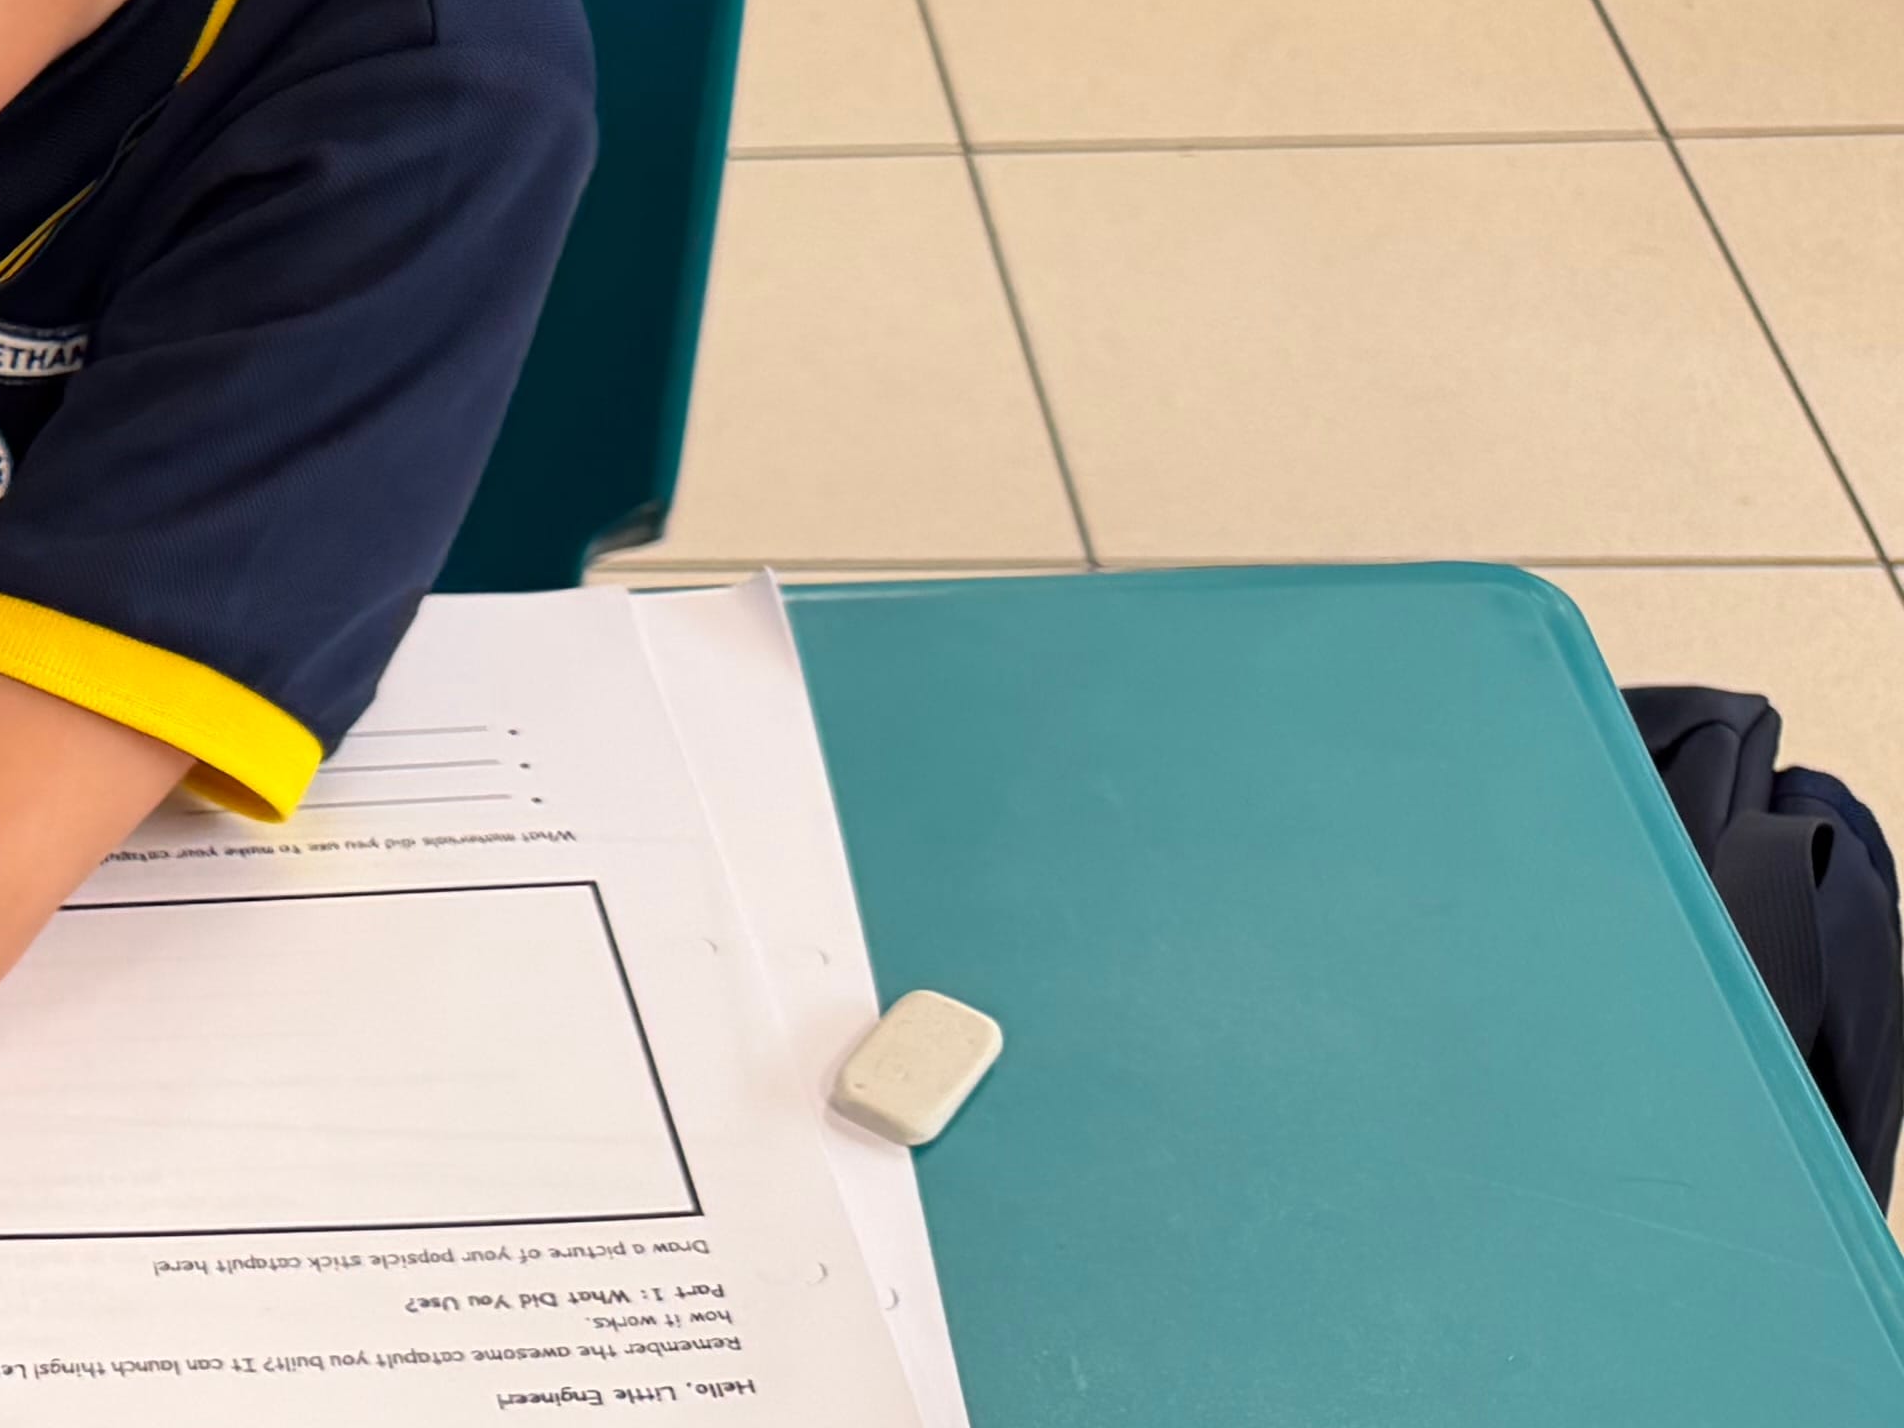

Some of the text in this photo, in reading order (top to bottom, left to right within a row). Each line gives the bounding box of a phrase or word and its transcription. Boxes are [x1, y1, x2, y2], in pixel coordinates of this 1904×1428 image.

[521, 830, 577, 843] What
[153, 1239, 711, 1277] Draw a picture of your popsicle stick catapult here!
[404, 1283, 725, 1314] Part 1: What Did You Use?
[586, 1310, 733, 1333] how it works.
[471, 1346, 572, 1362] awesome
[576, 1344, 618, 1361] the
[624, 1336, 743, 1357] Remember
[185, 1358, 224, 1371] can
[231, 1357, 258, 1374] It
[262, 1355, 326, 1373] built?
[329, 1350, 371, 1367] you
[375, 1347, 466, 1370] catapult
[33, 1358, 107, 1380] things!
[110, 1359, 181, 1378] launch
[496, 1379, 757, 1410] Hello, Little Engineer!
